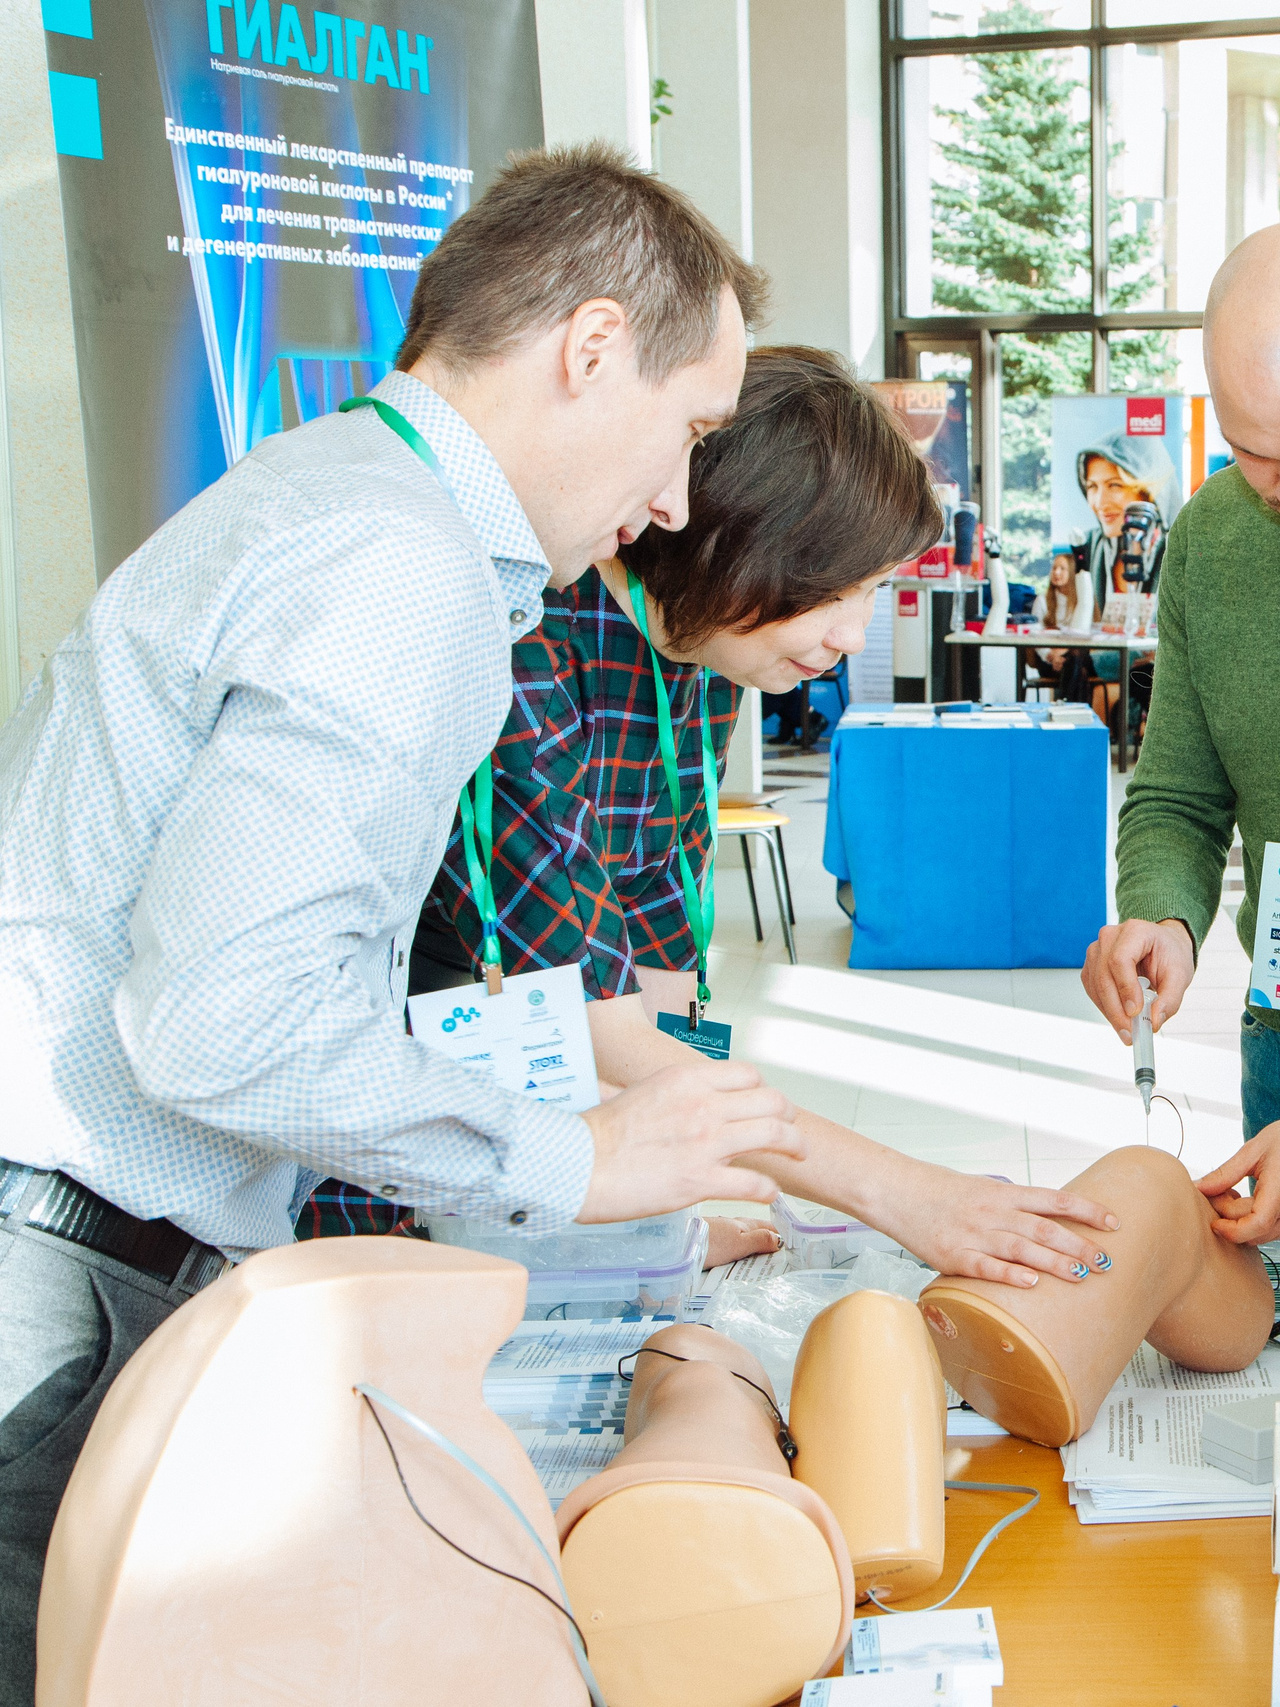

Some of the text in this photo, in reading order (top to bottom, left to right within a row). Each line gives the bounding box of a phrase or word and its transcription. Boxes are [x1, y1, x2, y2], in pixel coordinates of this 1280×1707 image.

[165, 117, 474, 186] Единственный лекарственный препарат
[197, 165, 320, 195] гиалуроновой
[321, 181, 383, 203] кислоты
[386, 189, 396, 205] в
[221, 204, 443, 241] для лечения травматических
[167, 235, 180, 252] и
[182, 236, 325, 264] дегенеративных
[1129, 413, 1162, 427] medi
[673, 1028, 724, 1047] Конференция
[528, 1054, 563, 1070] STORZ
